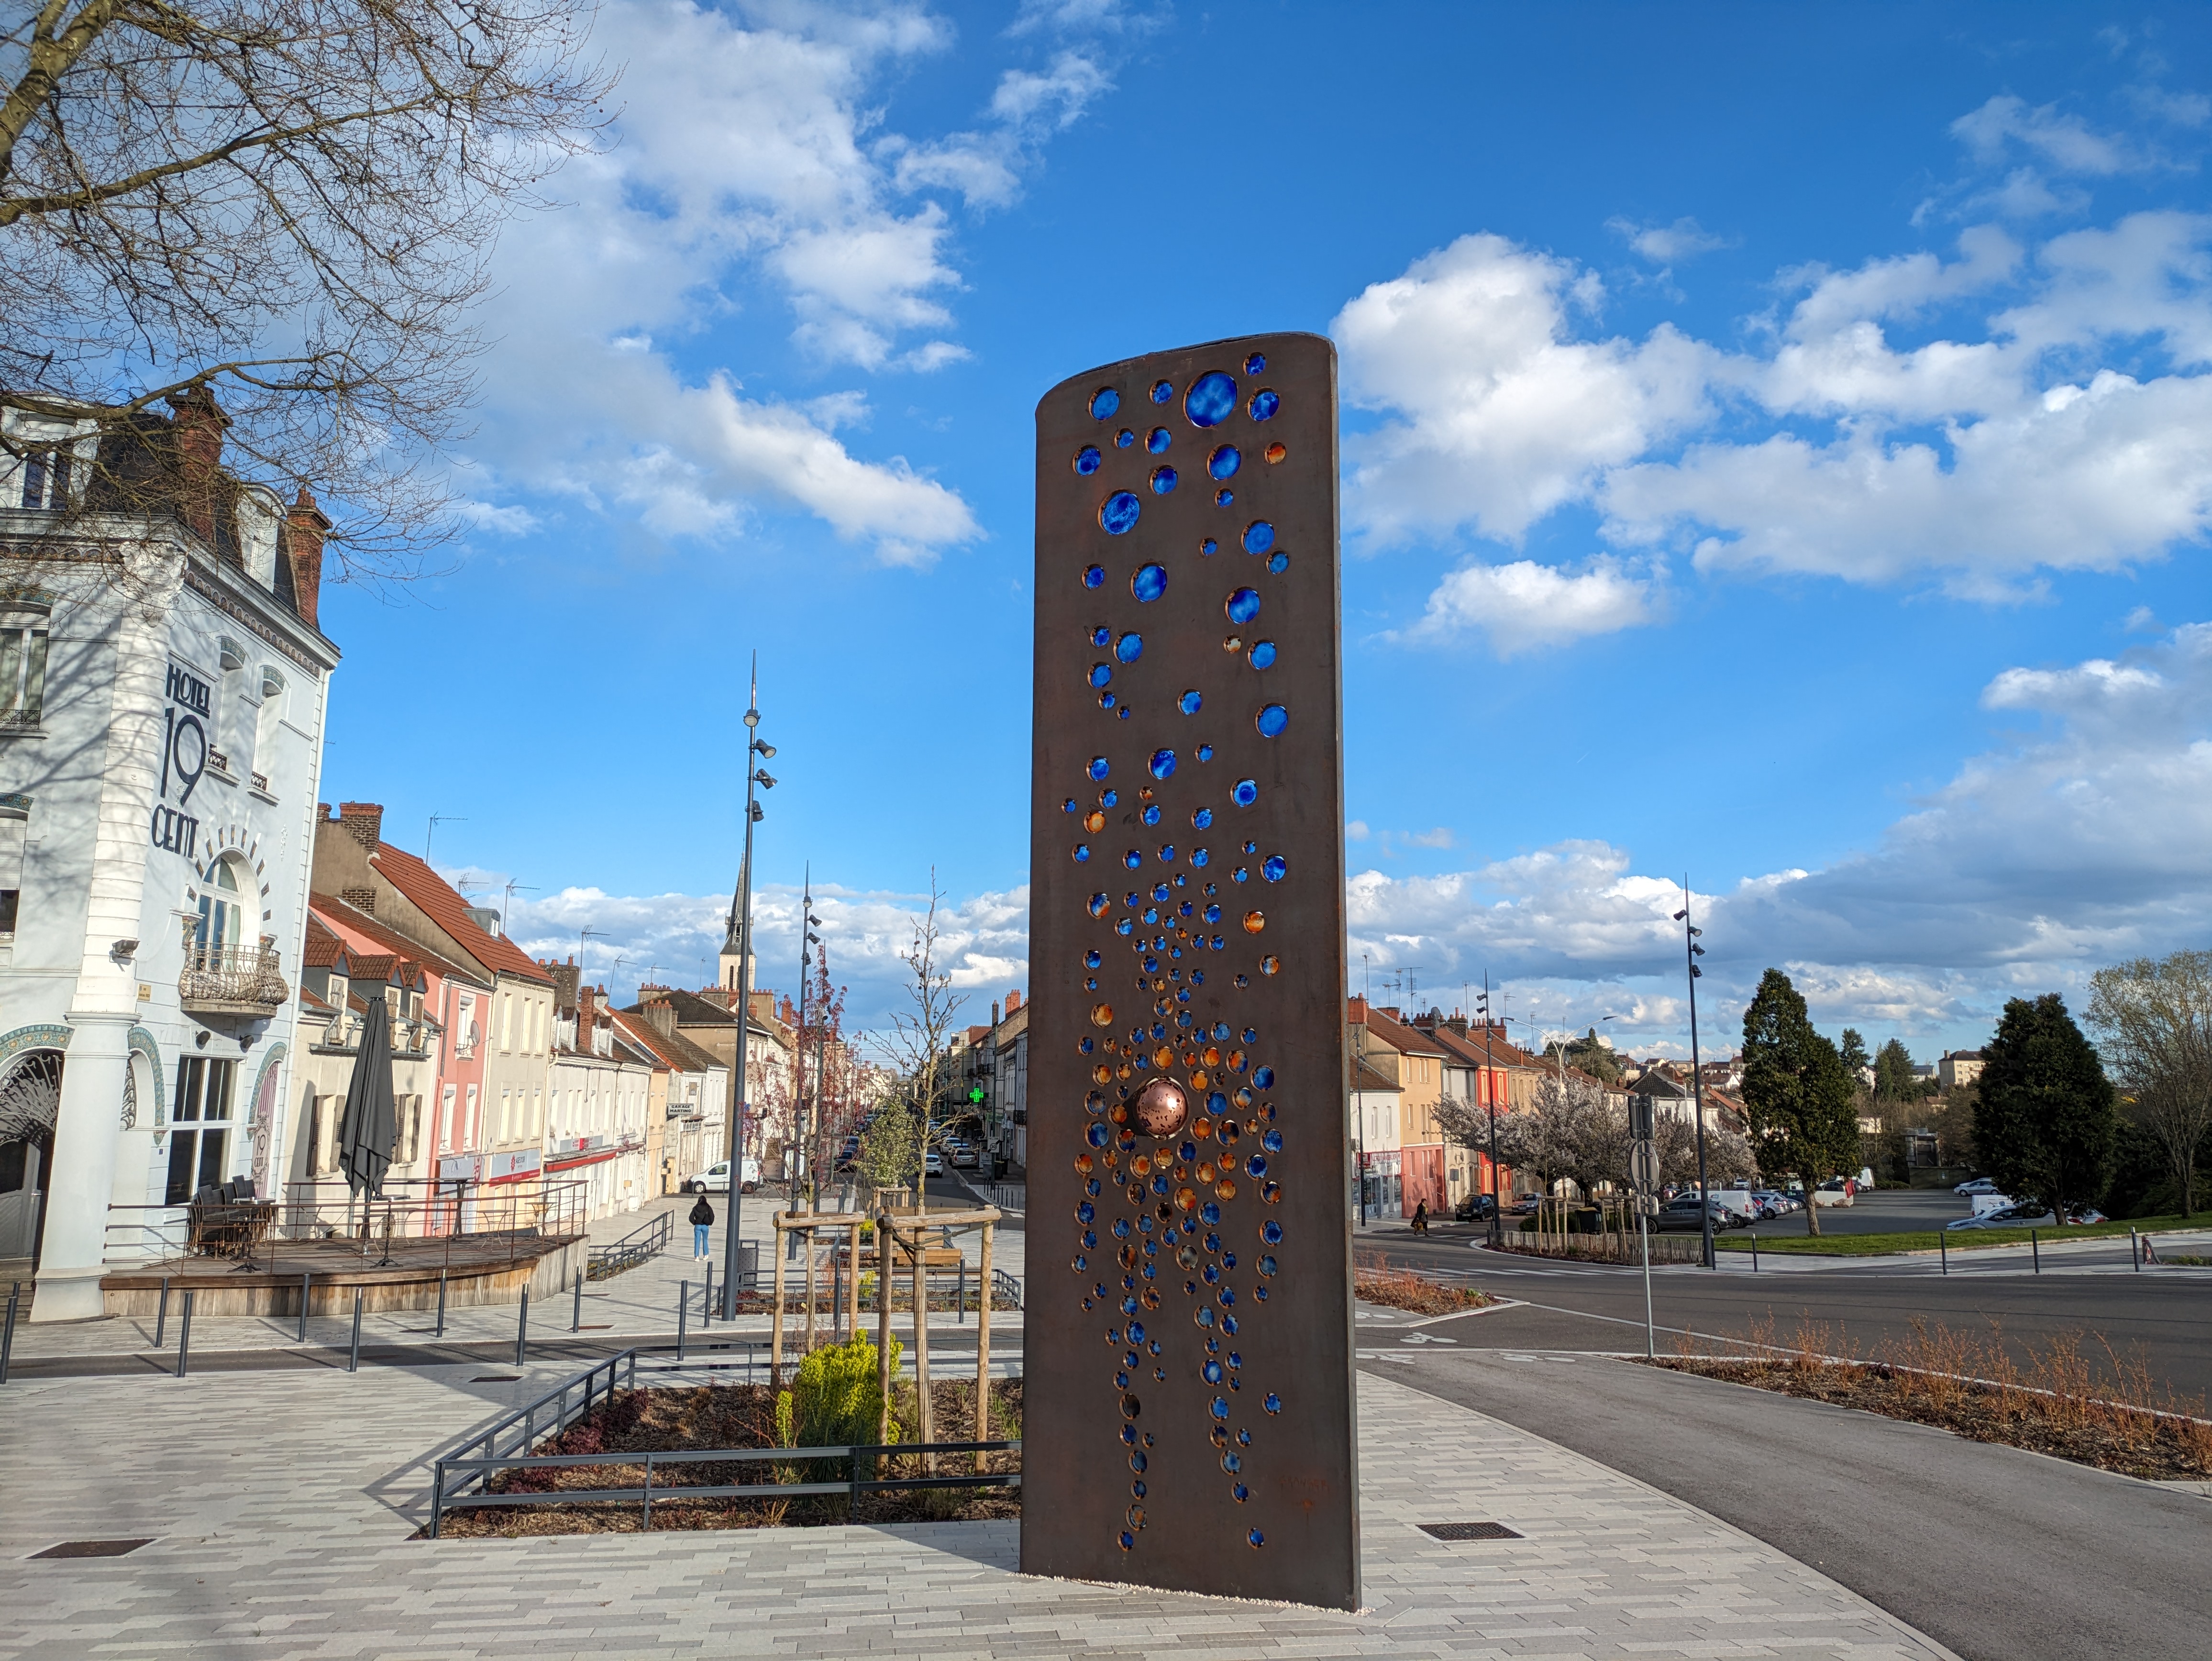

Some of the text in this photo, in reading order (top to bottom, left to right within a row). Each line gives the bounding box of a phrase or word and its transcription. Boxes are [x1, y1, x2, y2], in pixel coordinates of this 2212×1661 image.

[166, 663, 210, 719] HOTEL
[160, 707, 206, 808] 19
[256, 1134, 266, 1156] 19
